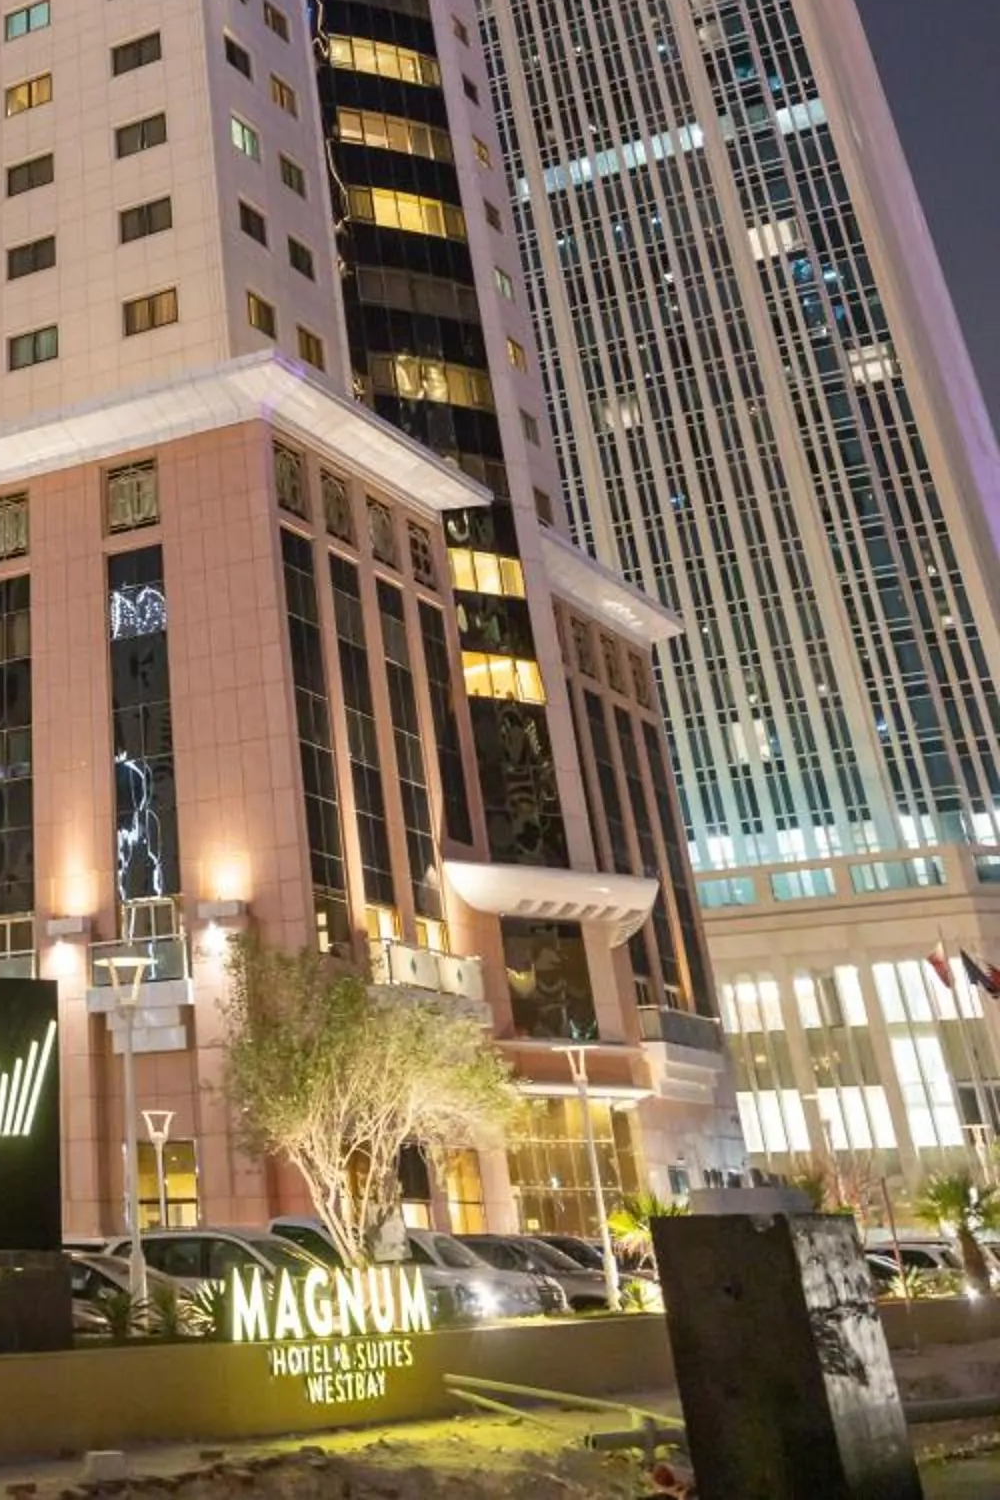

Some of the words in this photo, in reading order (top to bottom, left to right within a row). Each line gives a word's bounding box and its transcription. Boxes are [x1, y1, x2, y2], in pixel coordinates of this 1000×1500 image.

[232, 1267, 431, 1341] MAGNUM
[273, 1345, 333, 1376] HOTEL
[338, 1342, 350, 1370] &
[356, 1340, 413, 1369] SUITES
